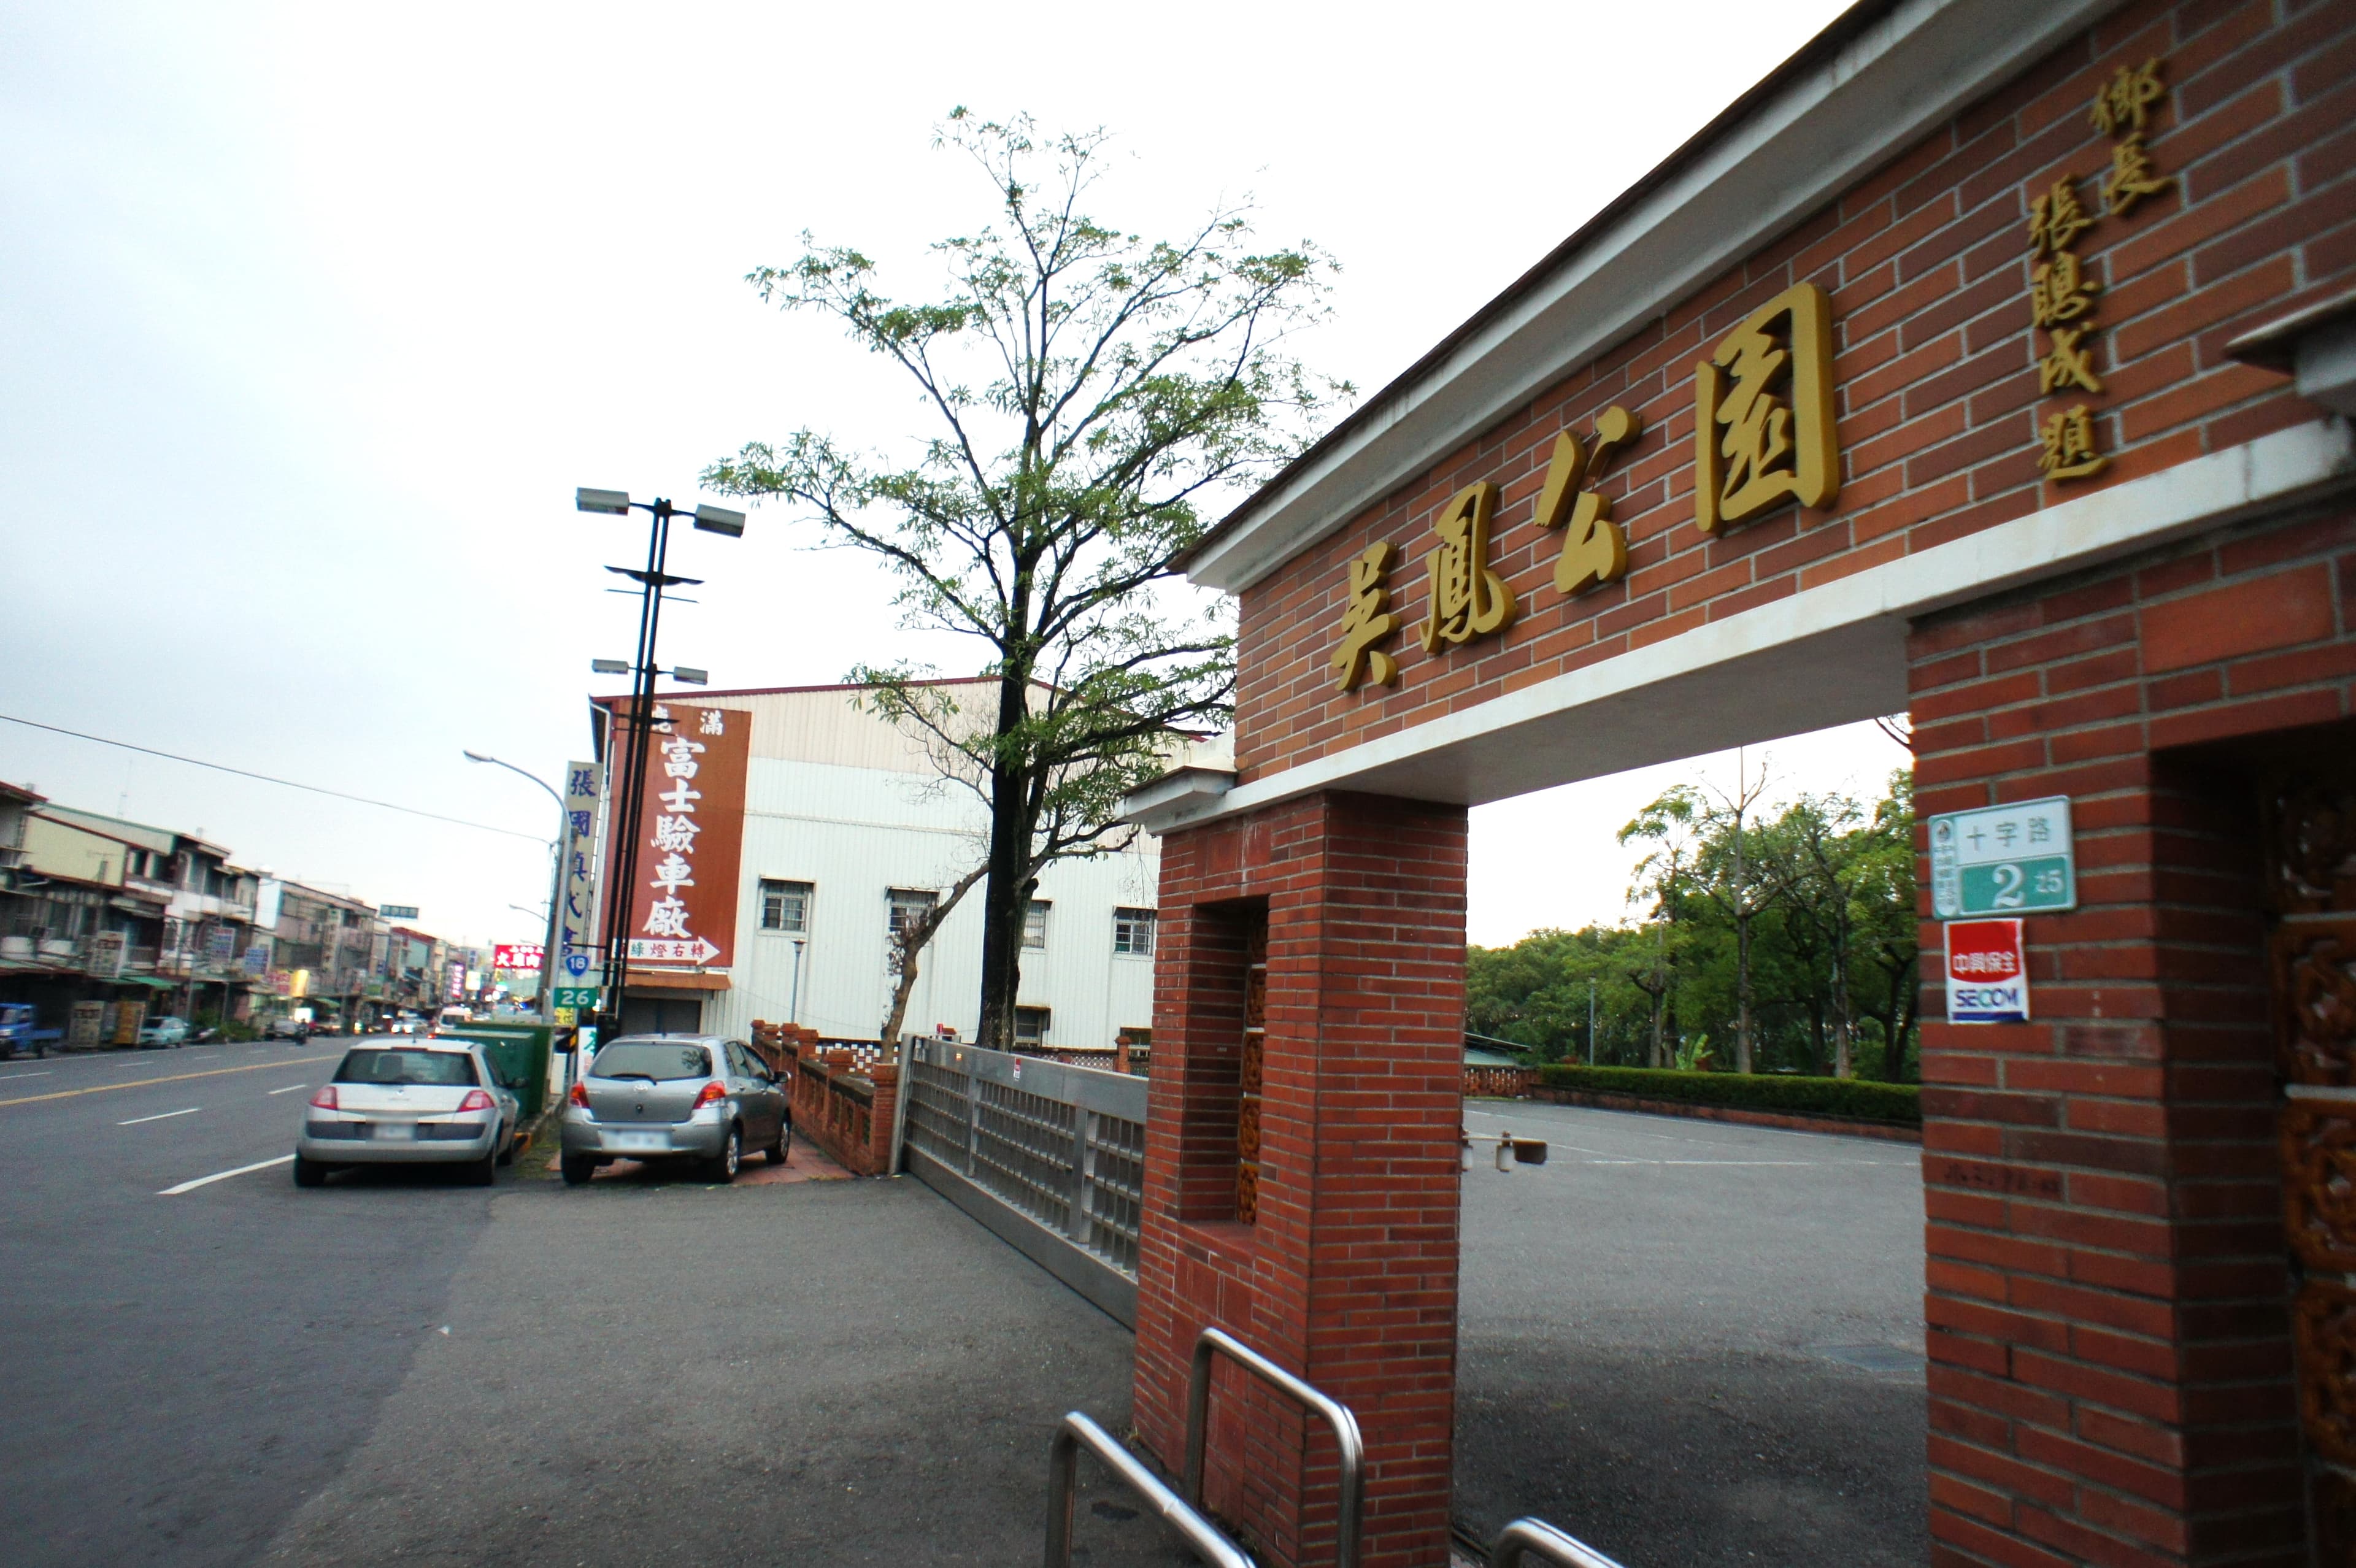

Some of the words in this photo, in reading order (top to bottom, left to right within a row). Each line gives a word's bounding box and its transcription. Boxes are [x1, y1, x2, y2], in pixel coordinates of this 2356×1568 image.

[1331, 282, 1841, 692] 吳鳳公園
[642, 734, 705, 939] 富士驗車廠
[1966, 816, 2050, 851] 十字路
[620, 942, 704, 958] 綠燈右轉
[570, 957, 586, 969] 18
[561, 990, 590, 1005] 26
[1955, 988, 2018, 1008] SECOM
